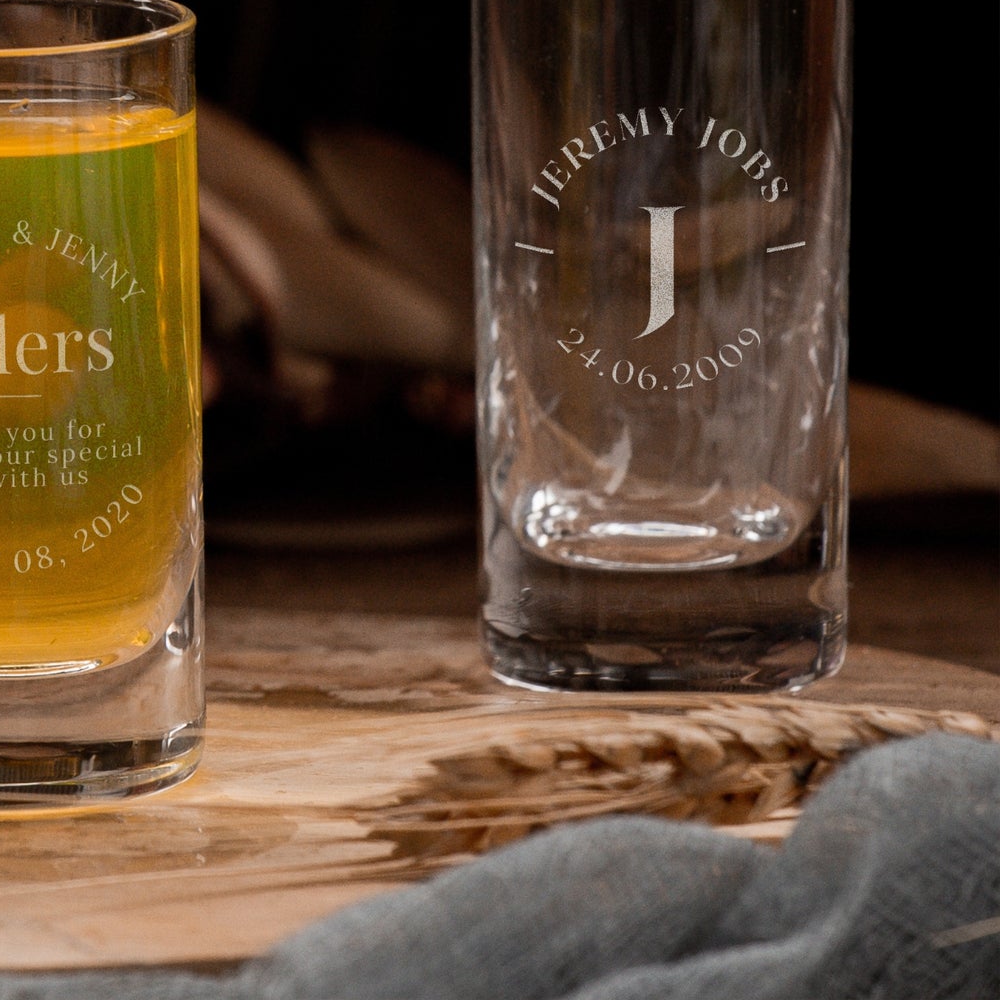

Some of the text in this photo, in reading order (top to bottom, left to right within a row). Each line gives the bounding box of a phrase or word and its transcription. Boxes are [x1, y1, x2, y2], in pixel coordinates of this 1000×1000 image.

[531, 106, 789, 212] JEREMY JOBS
[12, 219, 34, 246] &
[45, 227, 146, 304] JENNY
[631, 205, 686, 341] J
[556, 327, 762, 391] 24.06.2009
[6, 425, 54, 448] you
[66, 418, 106, 440] for
[47, 436, 142, 468] special
[60, 468, 89, 486] us
[14, 546, 67, 574] 08,
[73, 483, 143, 552] 2020
